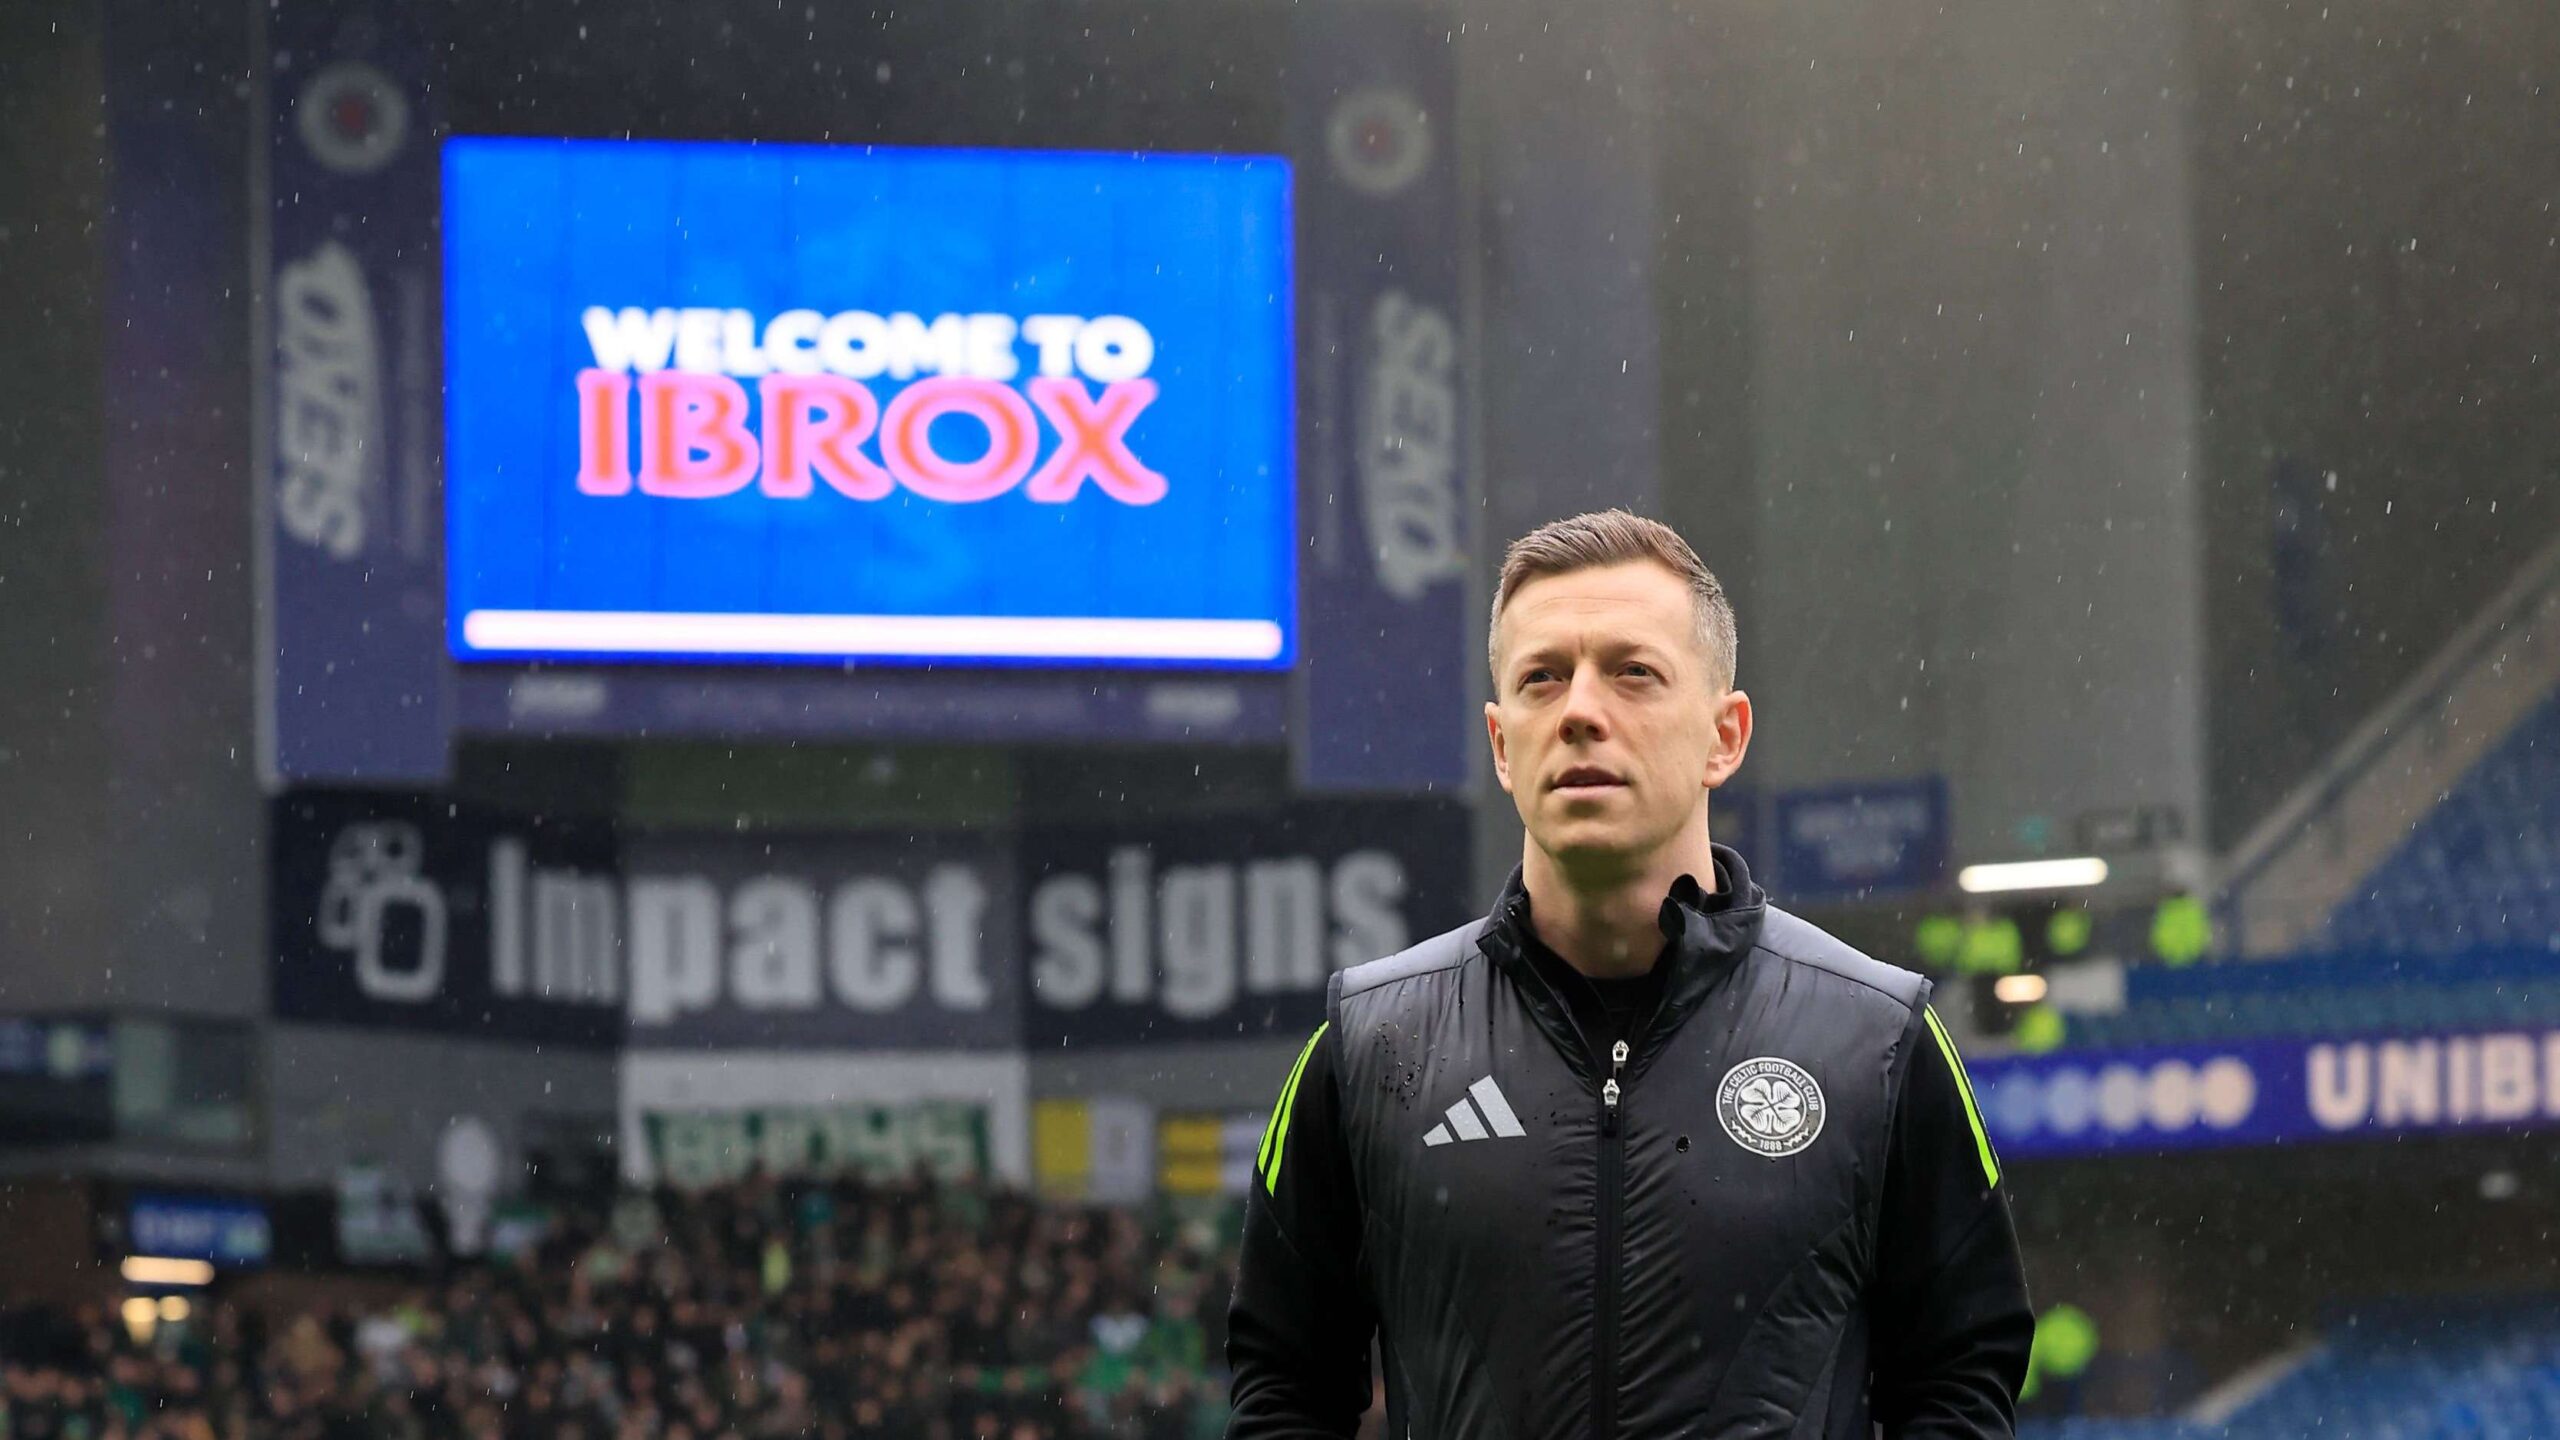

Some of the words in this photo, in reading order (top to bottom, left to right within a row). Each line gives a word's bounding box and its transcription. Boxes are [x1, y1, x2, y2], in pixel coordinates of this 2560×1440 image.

[583, 305, 1020, 381] WELCOME
[1022, 314, 1155, 384] TO
[278, 241, 376, 559] SEKO
[576, 367, 1169, 506] IBROX
[488, 834, 992, 1027] Impact
[1028, 846, 1408, 1020] signs
[1722, 1086, 1736, 1105] THE
[1729, 1064, 1758, 1088] CELTIC
[1758, 1062, 1806, 1088] FOOTBALL
[1803, 1085, 1820, 1111] CLUB
[1760, 1139, 1783, 1151] 1888
